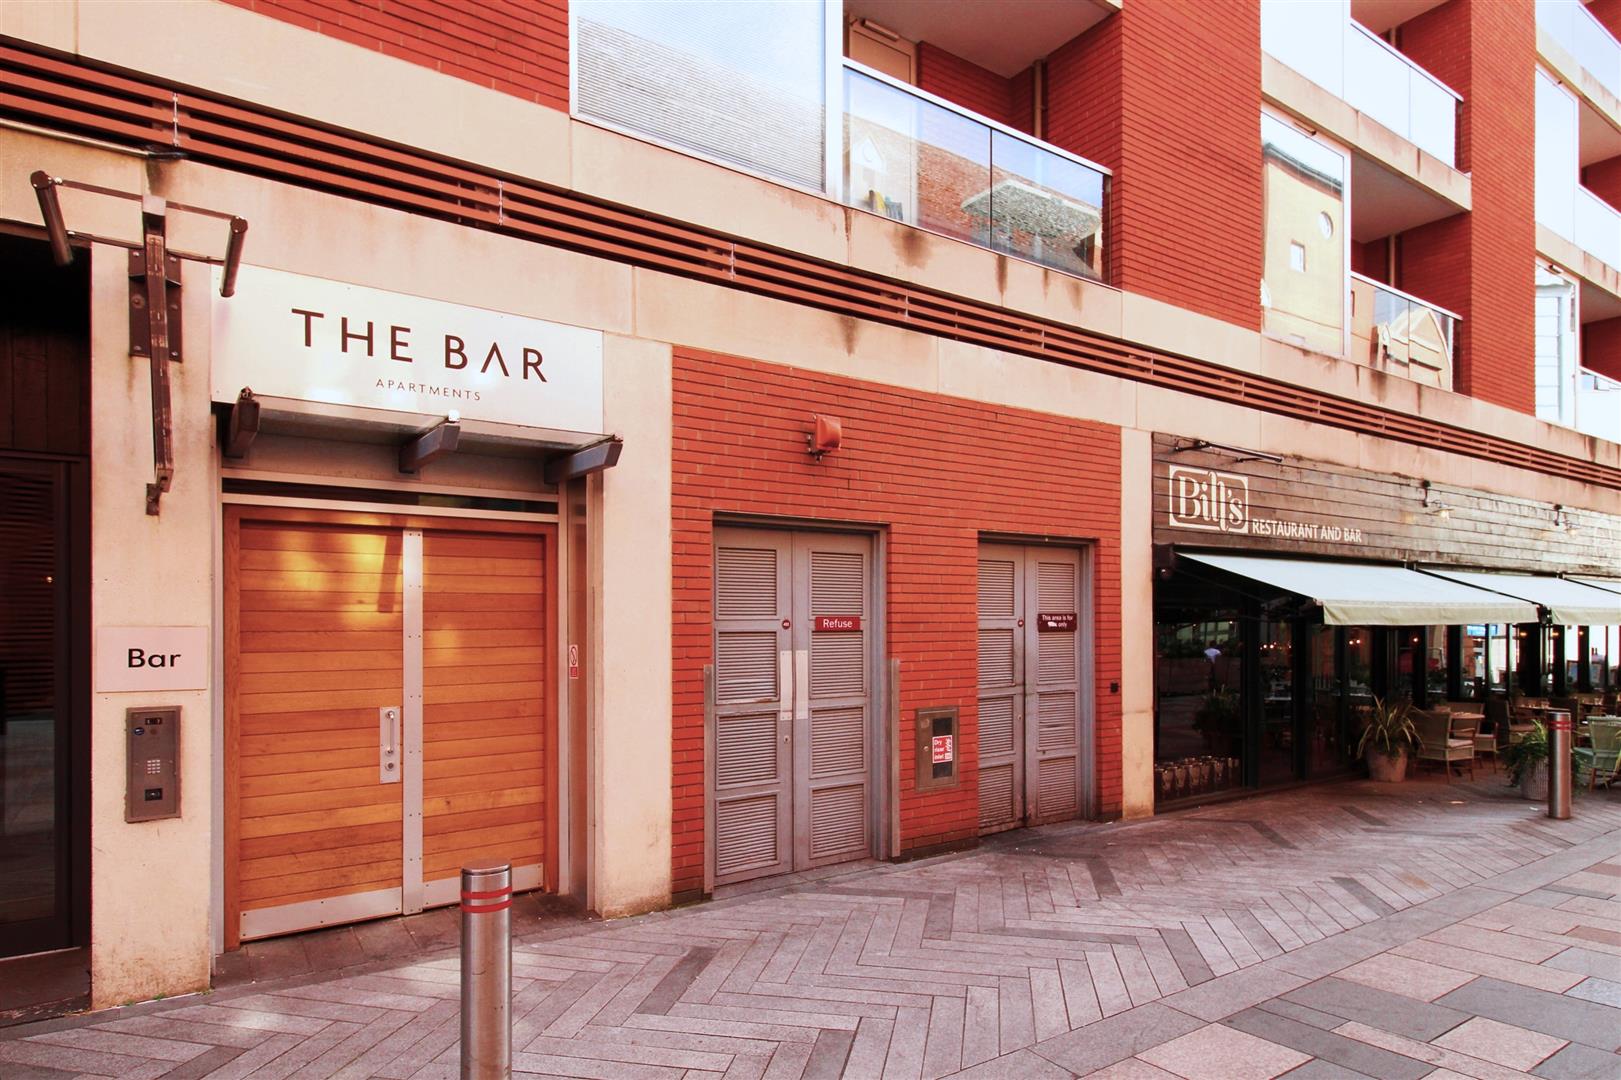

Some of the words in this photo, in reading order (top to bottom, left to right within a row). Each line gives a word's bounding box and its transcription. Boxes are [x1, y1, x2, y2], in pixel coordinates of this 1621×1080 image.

[292, 308, 413, 363] THE
[445, 334, 547, 383] BAR
[376, 378, 481, 401] APARTMENTS
[1178, 471, 1243, 532] Bill's
[1252, 518, 1319, 541] RESTAURANT
[1319, 525, 1342, 542] AND
[1343, 528, 1363, 544] BAR
[822, 618, 853, 628] Refuse
[127, 648, 182, 669] Bar
